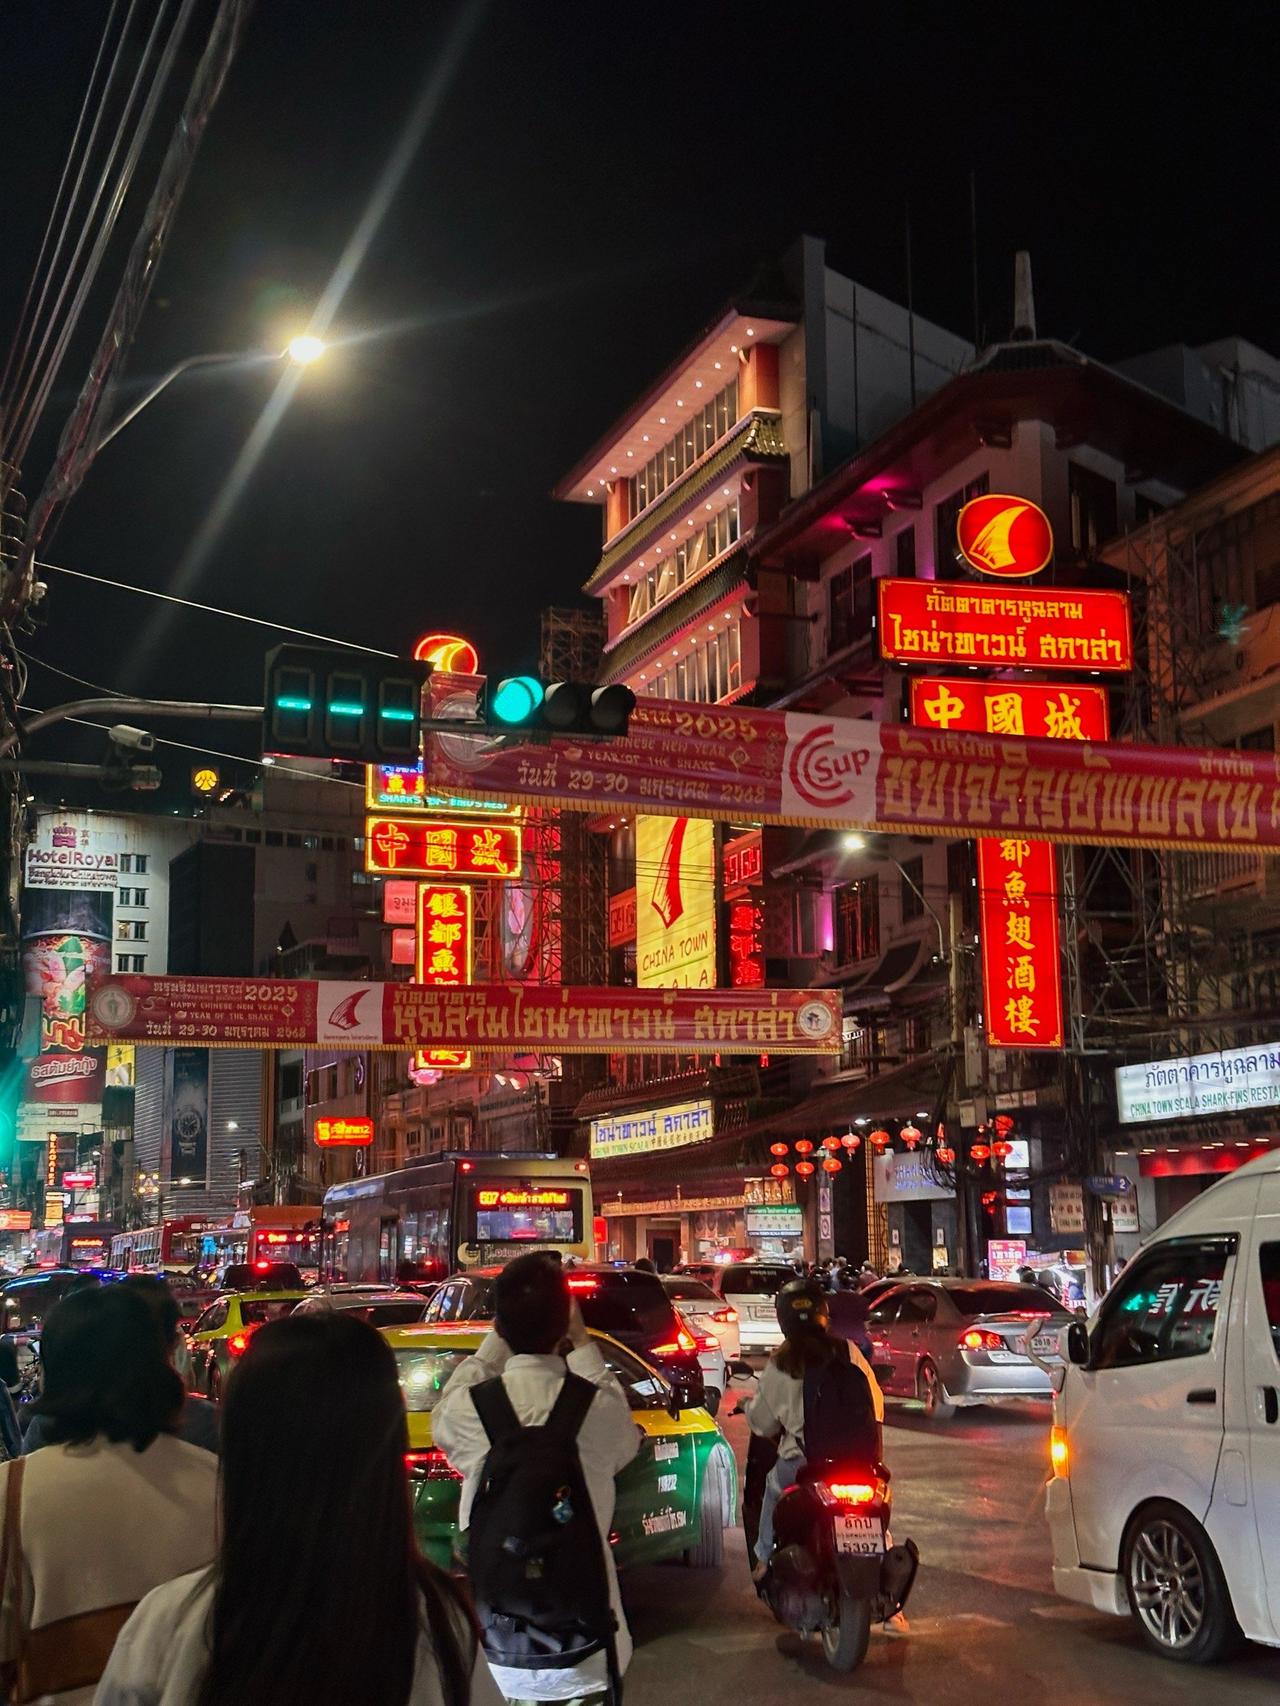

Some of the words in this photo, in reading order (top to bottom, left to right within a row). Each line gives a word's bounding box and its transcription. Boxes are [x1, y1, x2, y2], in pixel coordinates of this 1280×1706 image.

[926, 588, 1083, 624] ภัตตาคารหูฉลาม
[888, 613, 1027, 657] ไชน่าทาวน์
[1039, 629, 1122, 661] สกาล่า
[674, 711, 758, 742] 2025
[923, 684, 1092, 741] 中國城
[606, 735, 656, 750] HINESE
[517, 753, 558, 788] วันที่
[568, 768, 630, 795] 29-30
[426, 892, 465, 985] 銀都魚
[642, 945, 675, 972] CHINA
[679, 930, 709, 958] TOWN
[999, 838, 1041, 1037] 都魚翅酒樓
[170, 1001, 197, 1009] HAPPY
[200, 1001, 232, 1010] CHINESE
[244, 984, 298, 1001] 2025
[146, 1015, 172, 1036] วันที่
[178, 1024, 218, 1037] 29-30
[190, 1012, 211, 1020] YEAR
[214, 1012, 226, 1020] OF
[229, 1012, 244, 1020] THE
[694, 992, 800, 1042] สกาล่า
[1130, 1103, 1151, 1117] CHINA
[1152, 1099, 1174, 1114] TOWN
[1175, 1096, 1200, 1110] SCALA
[1201, 1088, 1249, 1107] SHARK-FINS
[1250, 1084, 1280, 1103] RESTA
[593, 1112, 657, 1143] ไชน่าทาวน์
[664, 1103, 709, 1133] สกาล่า
[842, 1542, 878, 1553] 5397
